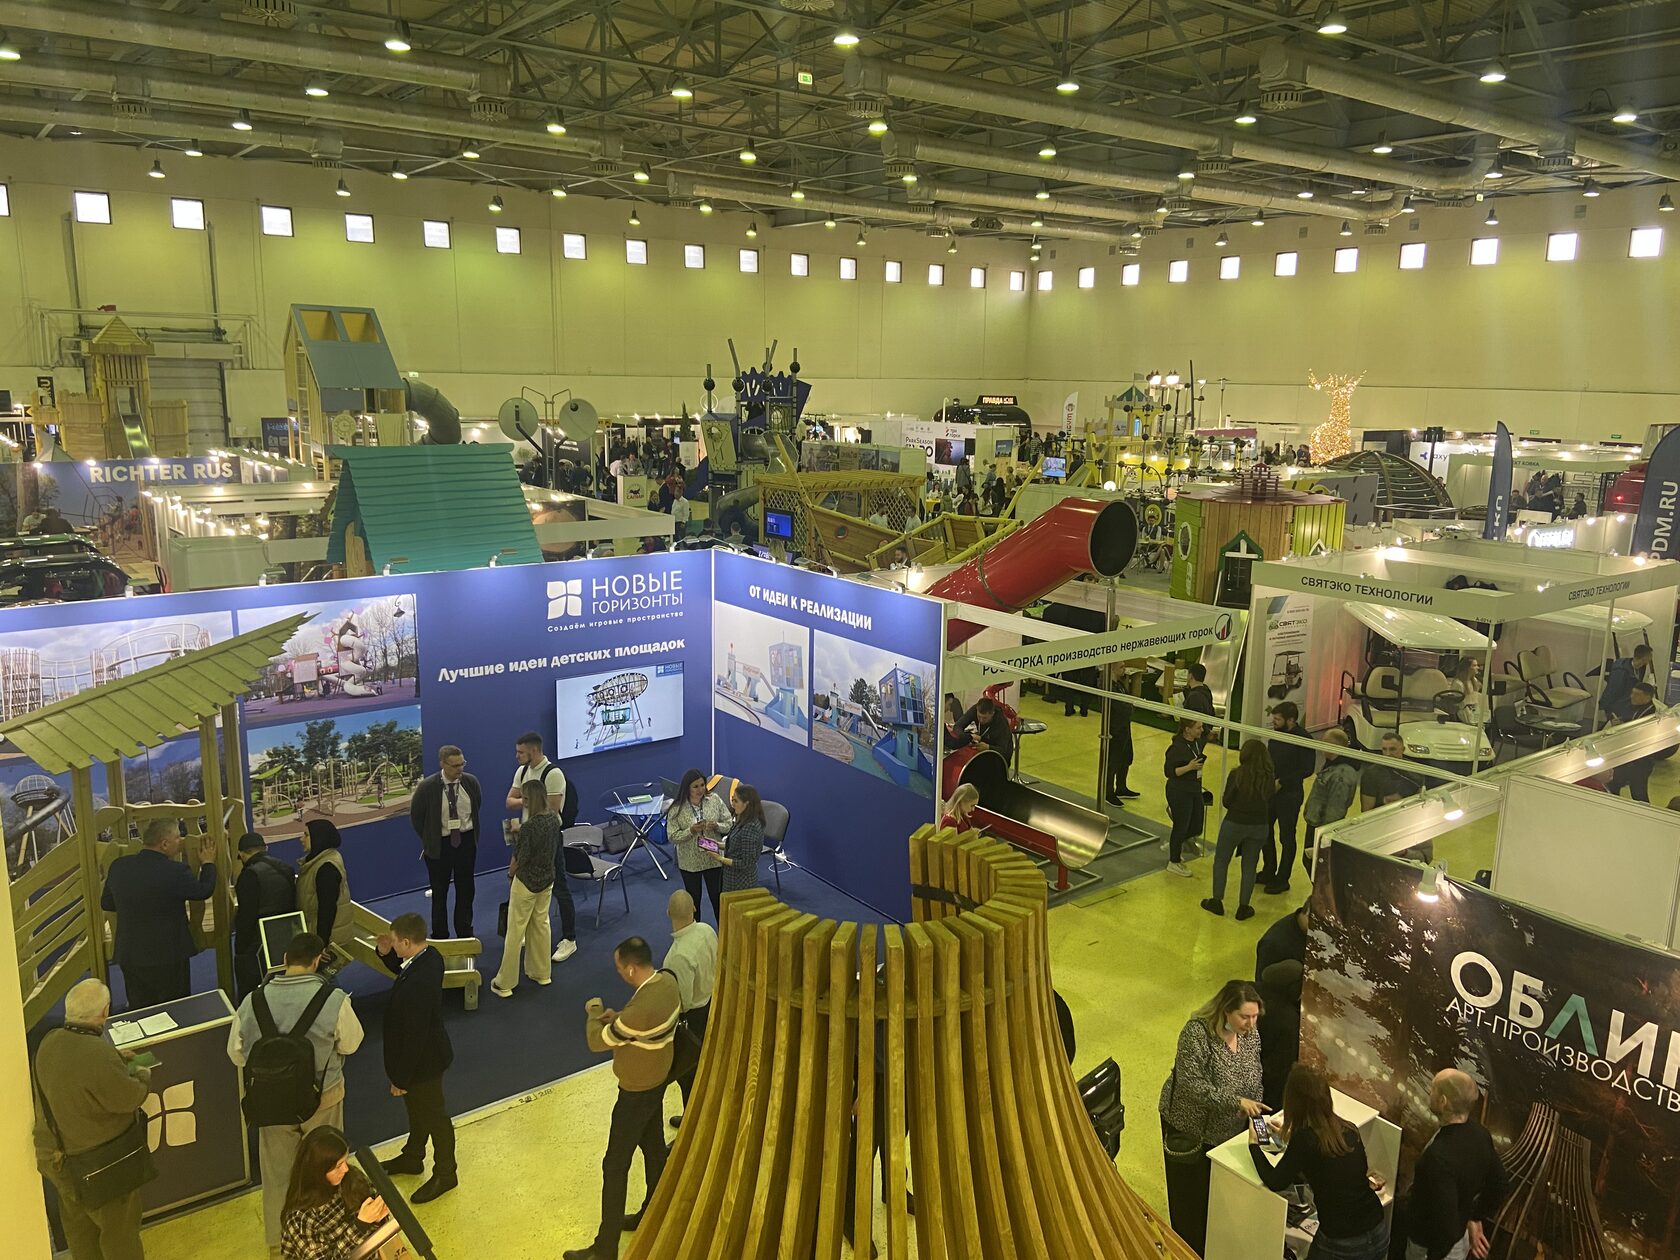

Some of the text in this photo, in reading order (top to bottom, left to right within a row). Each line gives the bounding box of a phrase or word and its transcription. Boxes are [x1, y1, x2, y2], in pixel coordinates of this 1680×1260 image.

[89, 462, 233, 483] RICHTER RUS
[592, 570, 683, 599] НОВЫЕ
[1301, 576, 1433, 606] СВЯТЭКО ТЕХНОЛОГИИ
[1568, 581, 1631, 601] СВЯТЭКО ТЕХНОЛОГИИ
[592, 592, 683, 614] ГОРИЗОНТЫ
[749, 584, 872, 630] ОТ ИДЕИ К РЕАЛИЗАЦИИ
[547, 611, 684, 632] Создаём игровые пространства
[438, 638, 686, 683] Лучшие идеи детских площадок
[1046, 643, 1118, 668] производство
[1120, 632, 1187, 652] нержавеющих
[1188, 625, 1214, 641] горок
